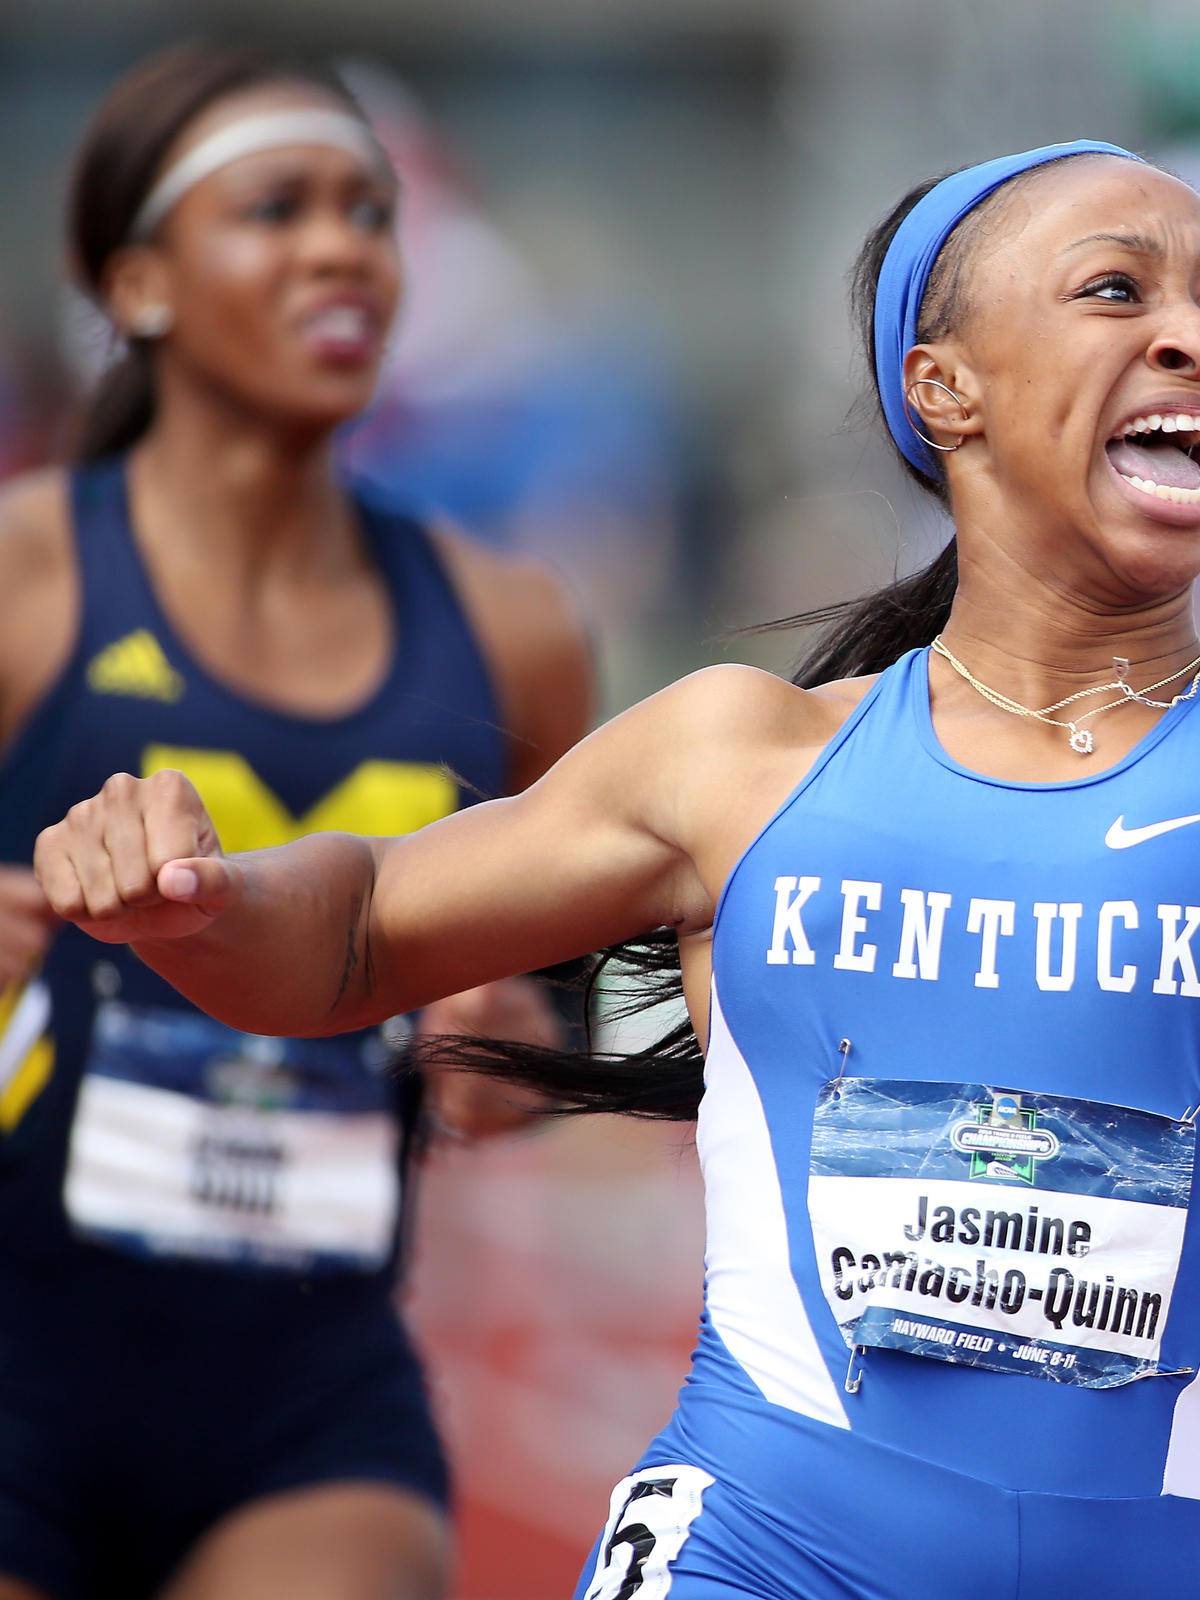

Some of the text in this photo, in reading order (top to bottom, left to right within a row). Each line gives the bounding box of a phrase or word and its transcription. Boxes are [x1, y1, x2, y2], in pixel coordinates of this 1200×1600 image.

[961, 1132, 1051, 1152] CHAMPIONSHIPS
[903, 1195, 1092, 1258] Jasmine
[831, 1246, 1162, 1340] Camacho-Quinn
[892, 1318, 954, 1345] HAYWARD
[954, 1331, 994, 1352] FIELD
[1012, 1343, 1049, 1365] JUNE
[1049, 1350, 1077, 1368] 8-11
